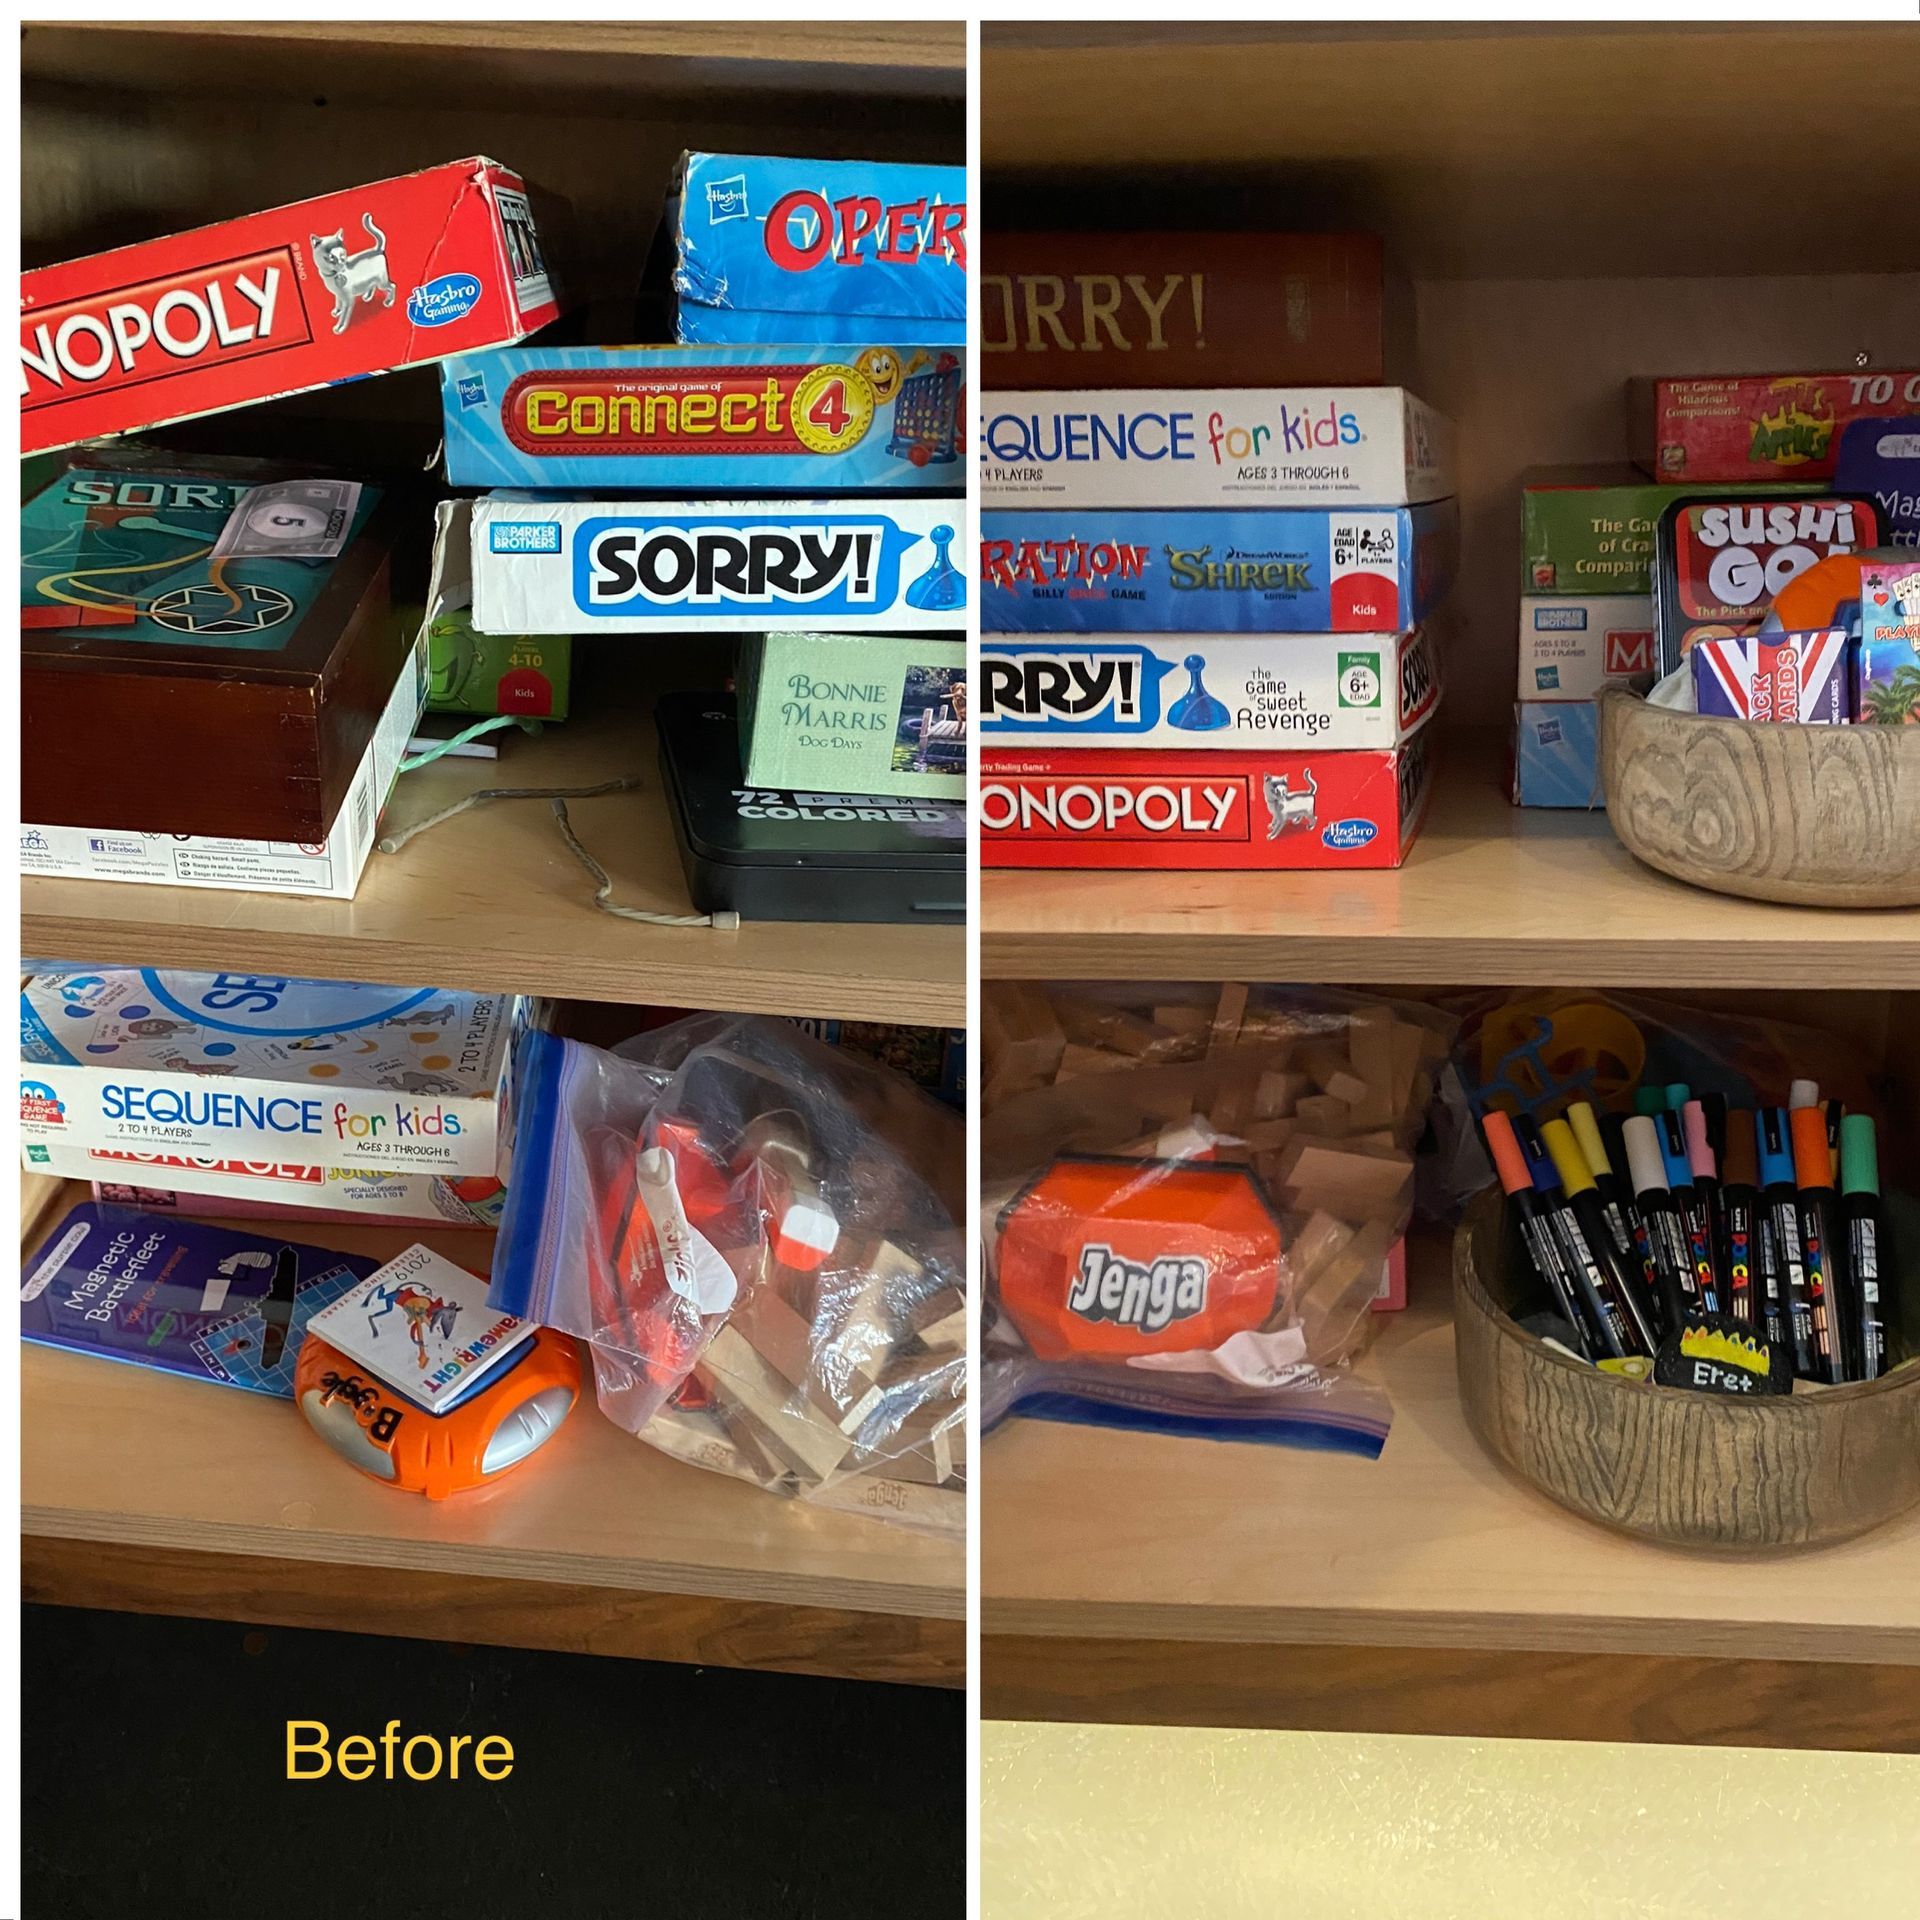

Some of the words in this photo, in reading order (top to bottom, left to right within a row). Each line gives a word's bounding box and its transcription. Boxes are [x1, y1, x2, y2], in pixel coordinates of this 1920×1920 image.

[706, 189, 747, 203] Hasbro
[764, 188, 966, 272] OPER
[409, 284, 476, 311] Hasbro
[423, 302, 468, 321] Gaming
[457, 382, 485, 395] Hasbro
[614, 384, 635, 392] The
[637, 383, 678, 394] original
[680, 383, 708, 393] game
[711, 382, 722, 392] of
[1668, 383, 1691, 394] The
[1692, 382, 1725, 393] Game
[1726, 382, 1740, 392] of
[1850, 376, 1895, 405] TO
[526, 377, 785, 436] Connect
[808, 380, 851, 436] 4
[1678, 394, 1729, 405] Hilarious
[1665, 406, 1741, 419] Comparisons!
[1207, 411, 1272, 465] for
[1281, 401, 1361, 454] kids
[985, 468, 991, 480] 4
[995, 468, 1043, 481] PLAYERS
[1237, 467, 1267, 480] AGES
[1271, 467, 1278, 479] 3
[1281, 466, 1340, 480] THROUGH
[1342, 467, 1349, 479] 6
[510, 526, 556, 538] PARKER
[1336, 528, 1353, 537] AGE
[1591, 518, 1623, 533] The
[494, 537, 557, 549] BROTHERS
[1334, 538, 1355, 547] EDAD
[1599, 538, 1618, 553] of
[596, 531, 872, 596] SORRY!
[1334, 549, 1354, 566] 6+
[1575, 557, 1648, 577] Compari
[1033, 588, 1065, 599] SILLY
[1111, 588, 1147, 600] GAME
[1352, 604, 1377, 616] Kids
[1695, 606, 1716, 617] The
[1720, 606, 1746, 616] Pick
[508, 653, 543, 668] 4-10
[1347, 655, 1371, 665] Family
[1557, 649, 1586, 657] PLAYERS
[1251, 666, 1271, 680] The
[1351, 670, 1367, 678] AGE
[1349, 678, 1369, 693] 6+
[1777, 648, 1797, 722] ARDS
[1830, 679, 1840, 703] CARDS
[514, 688, 535, 698] Kids
[1349, 693, 1371, 701] EDAD
[1257, 690, 1307, 712] sweet
[1237, 708, 1330, 736] Revenge
[994, 762, 1021, 773] Trading
[1022, 763, 1044, 772] Game
[731, 790, 784, 805] 72
[737, 805, 950, 823] COLORED
[980, 784, 1237, 832] ONOPOLY
[1325, 821, 1374, 839] Hasbro
[107, 846, 142, 854] Facebook
[467, 999, 493, 1039] PLAYERS
[23, 1114, 48, 1122] GAME
[102, 1084, 323, 1134] SEQUENCE
[334, 1103, 386, 1140] for
[395, 1103, 462, 1137] kids
[118, 1123, 125, 1133] 2
[127, 1124, 140, 1134] TO
[142, 1125, 149, 1134] 4
[151, 1126, 193, 1138] PLAYERS
[357, 1141, 381, 1152] AGES
[384, 1143, 390, 1152] 3
[393, 1144, 442, 1157] THROUGH
[443, 1147, 450, 1157] 6
[327, 1166, 414, 1181] JUNIO
[344, 1186, 375, 1194] SPECIALLY
[64, 1232, 135, 1310] Magnetic
[365, 1248, 420, 1289] CELEBRATING
[395, 1253, 431, 1281] 2019
[85, 1232, 166, 1322] Battlefleet
[1071, 1251, 1204, 1328] Jenga
[320, 1297, 350, 1320] YEARS
[1692, 1360, 1753, 1392] Eret
[320, 1371, 404, 1443] Boggle
